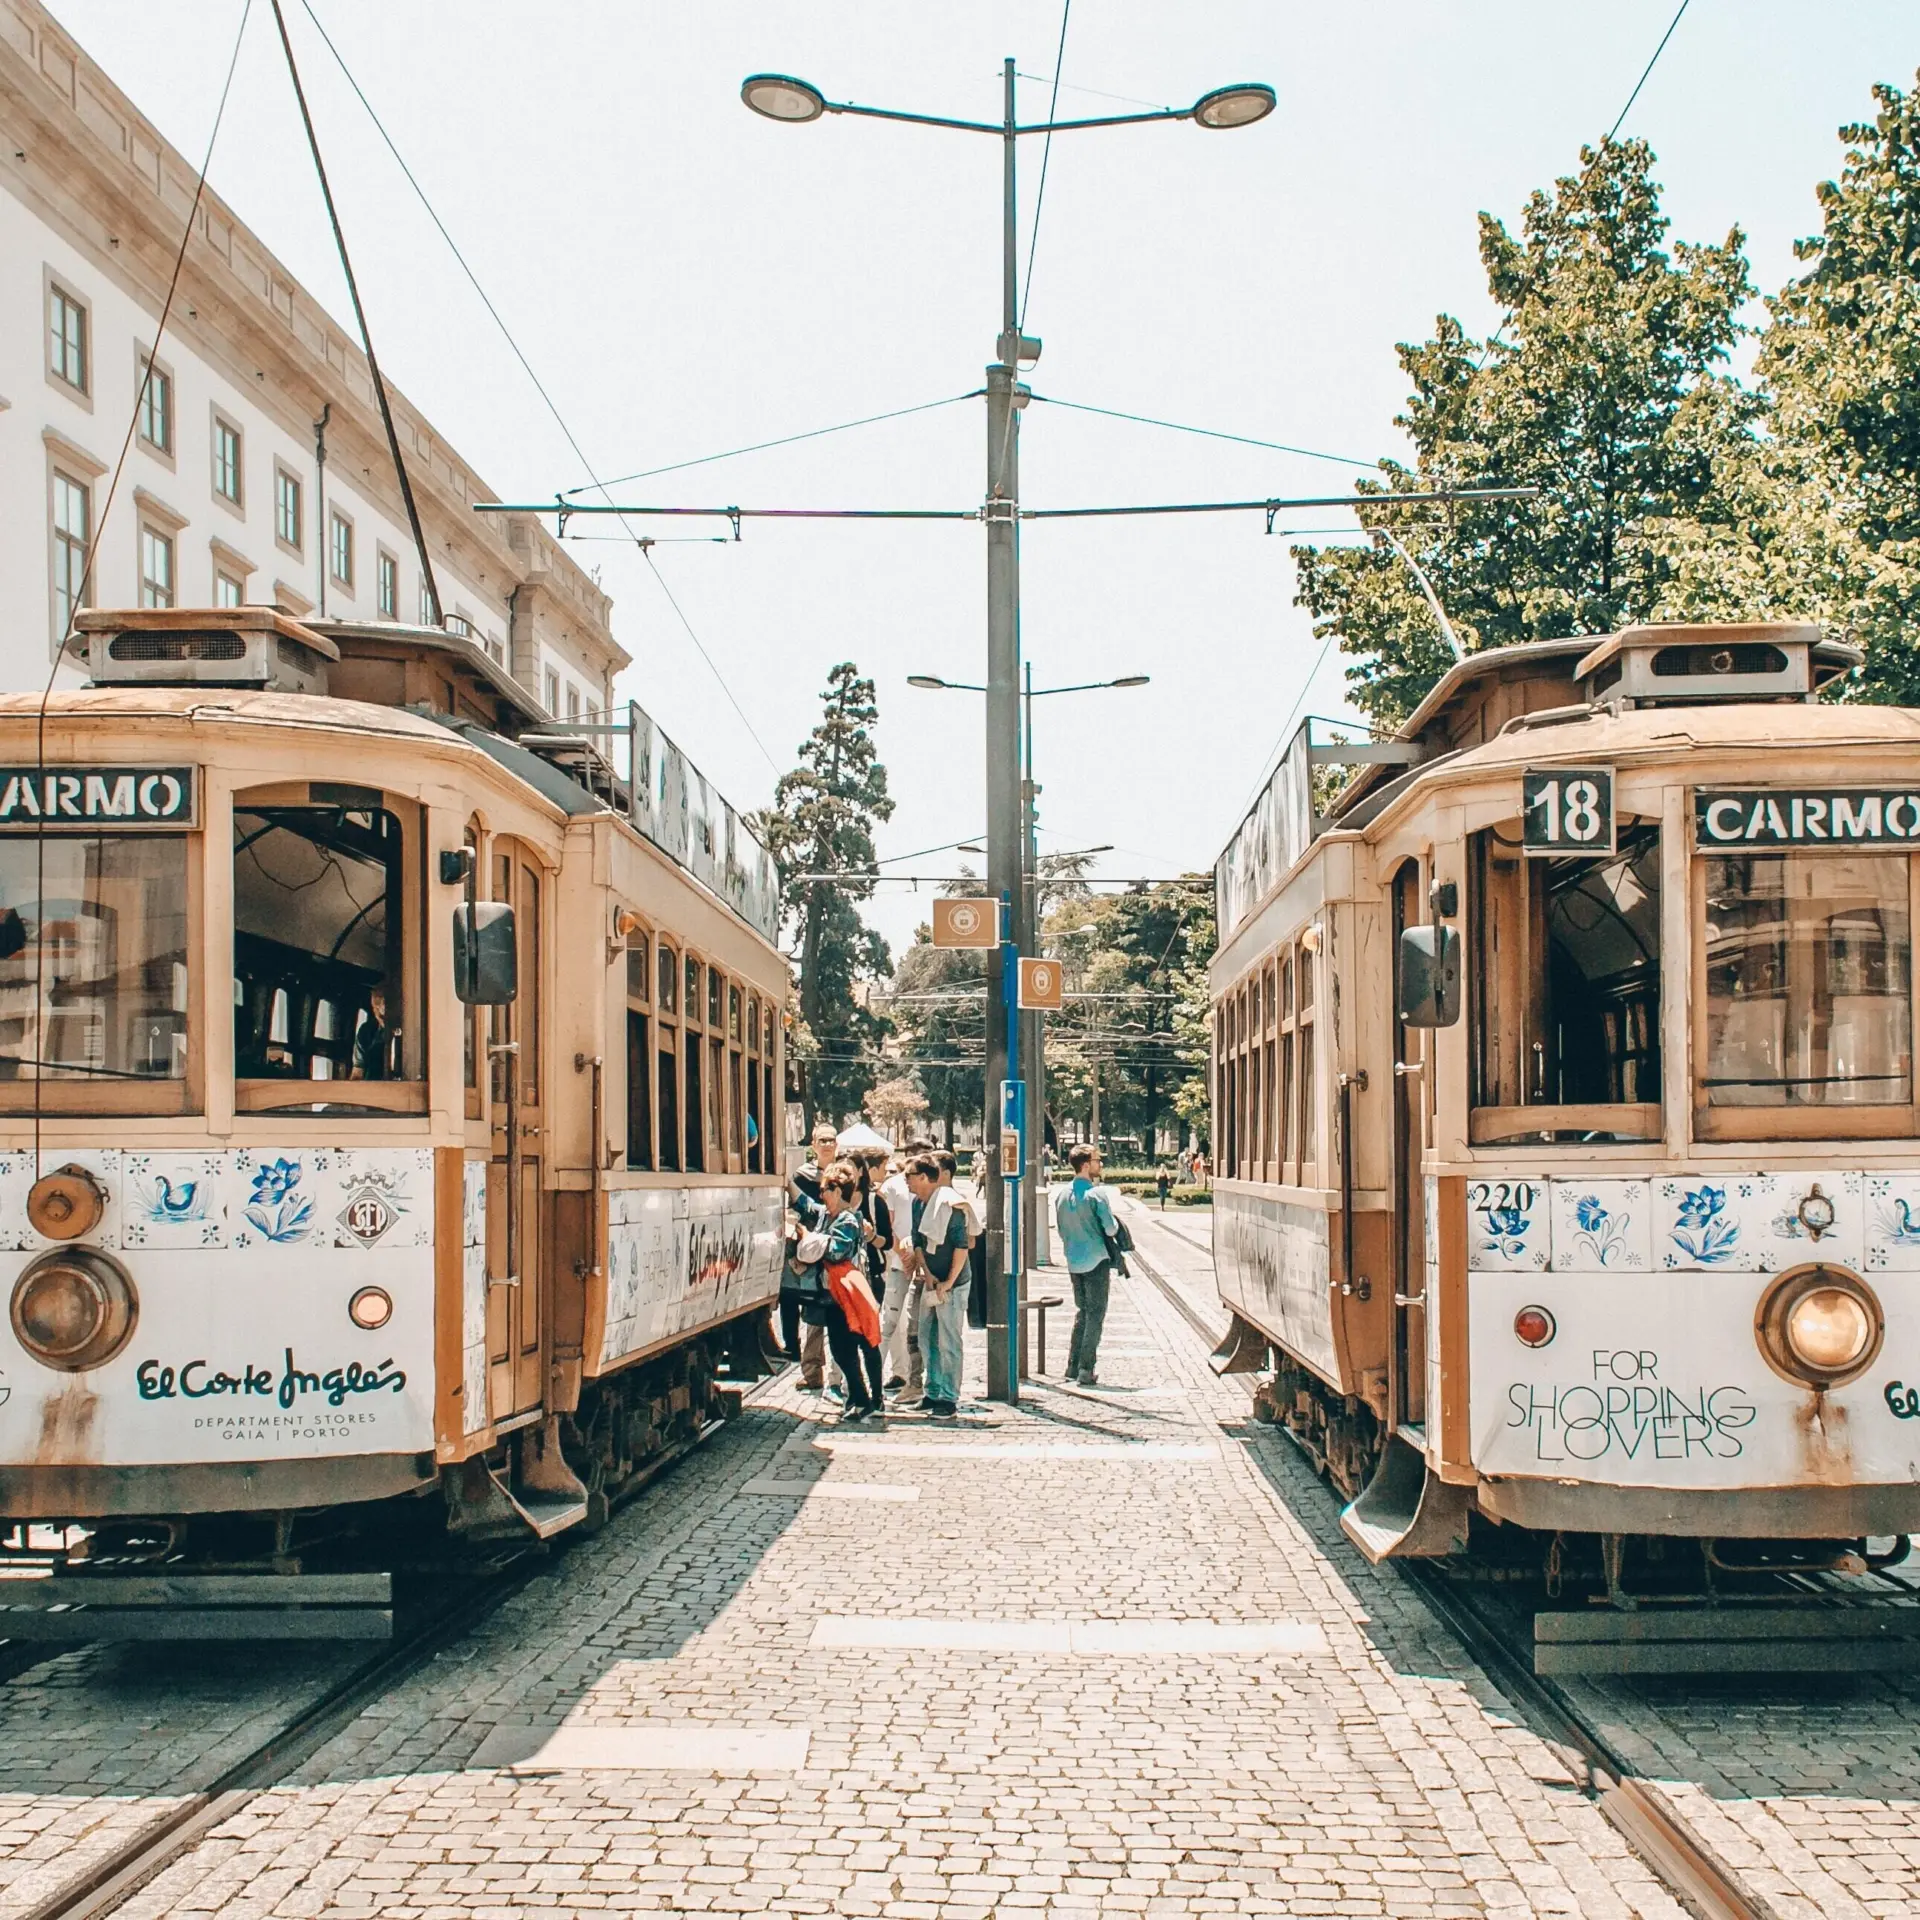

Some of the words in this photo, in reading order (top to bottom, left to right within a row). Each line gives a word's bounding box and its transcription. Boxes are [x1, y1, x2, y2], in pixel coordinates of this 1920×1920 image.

[1534, 780, 1600, 841] 18
[1706, 796, 1920, 840] CARMO
[1475, 1183, 1533, 1212] 220
[137, 1360, 177, 1400] El
[180, 1360, 273, 1398] Corte
[279, 1348, 407, 1409] Inglés
[1593, 1350, 1657, 1380] FOR
[1507, 1383, 1756, 1430] SHOPPING
[1884, 1381, 1920, 1419] El
[194, 1416, 303, 1428] DEPARTMENT
[314, 1414, 376, 1424] STORES
[223, 1430, 264, 1440] GAIA
[292, 1427, 350, 1438] PORTO
[1538, 1415, 1743, 1460] LOVERS
